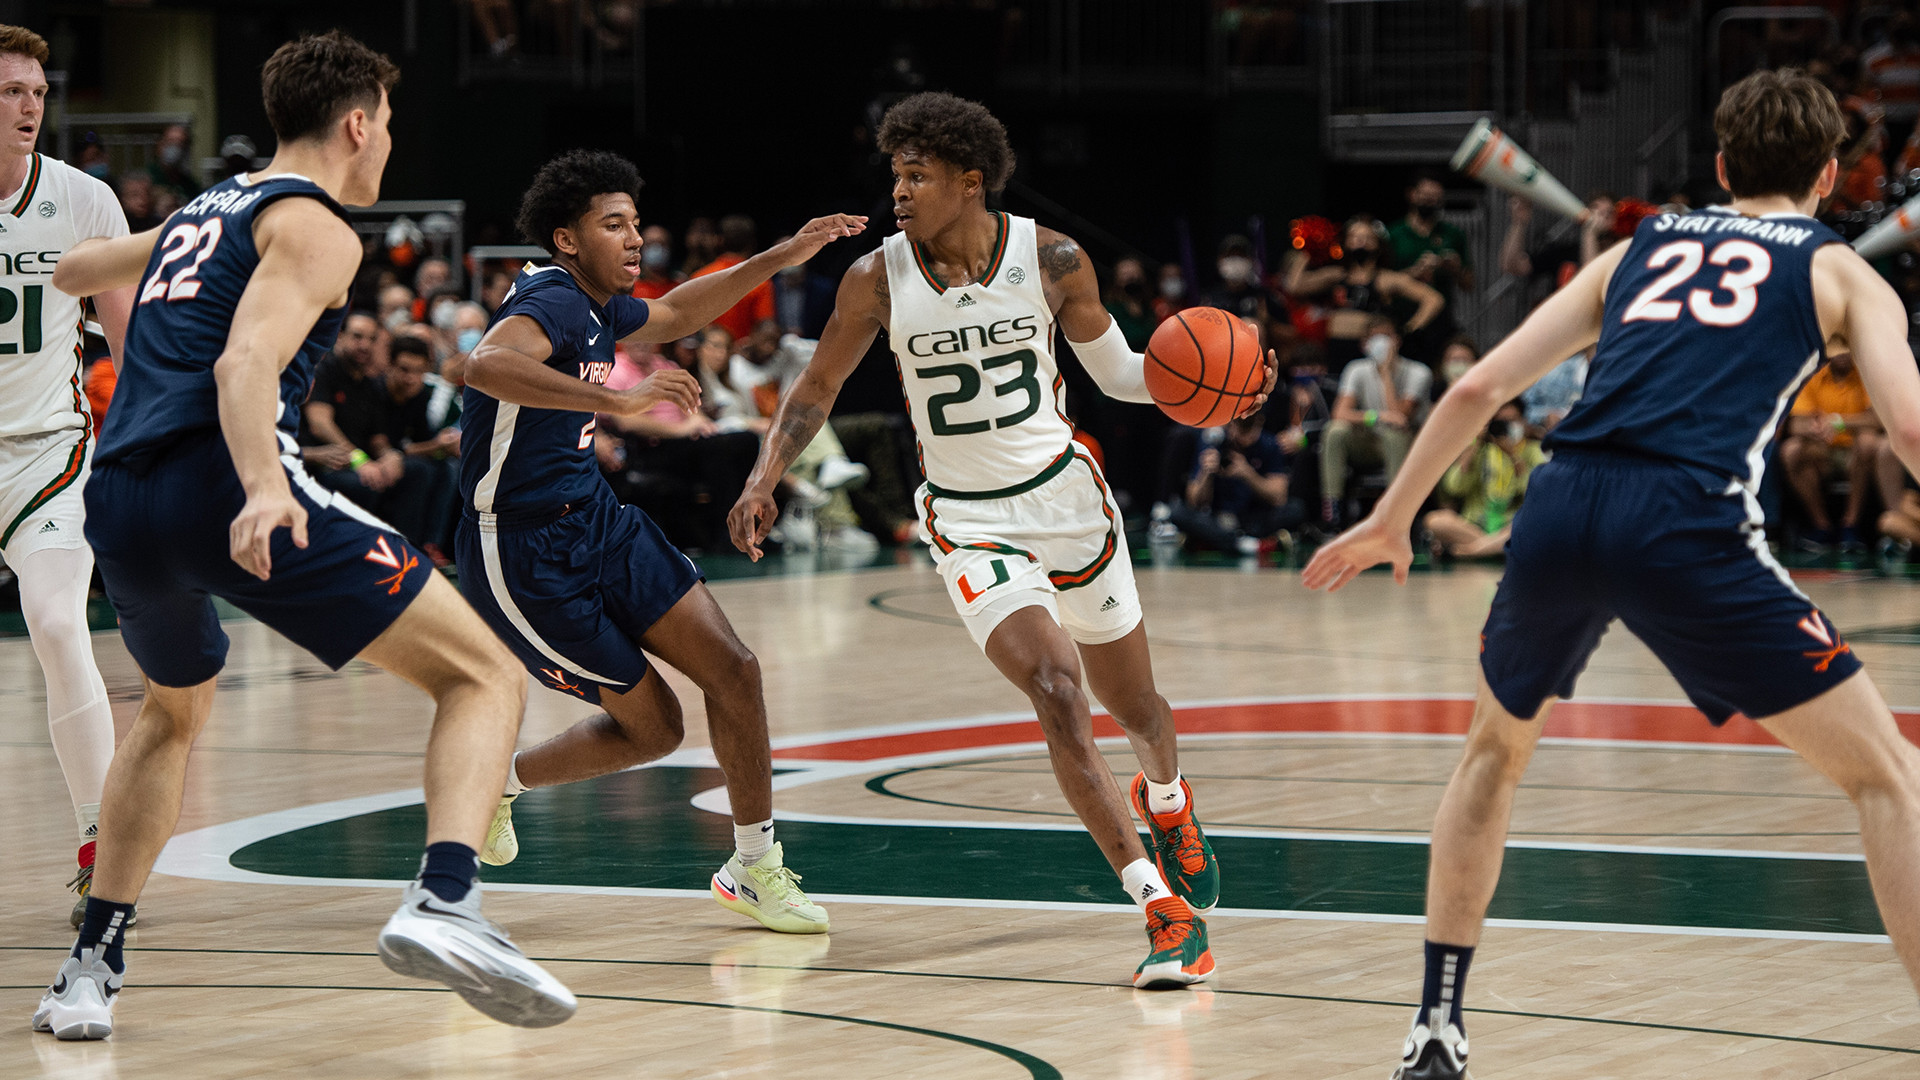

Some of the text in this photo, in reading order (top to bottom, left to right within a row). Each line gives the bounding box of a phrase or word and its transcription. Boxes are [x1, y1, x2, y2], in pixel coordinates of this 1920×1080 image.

[138, 217, 223, 306] 22
[1653, 213, 1814, 247] STATTMANN
[1621, 239, 1773, 328] 23
[914, 348, 1042, 436] 23
